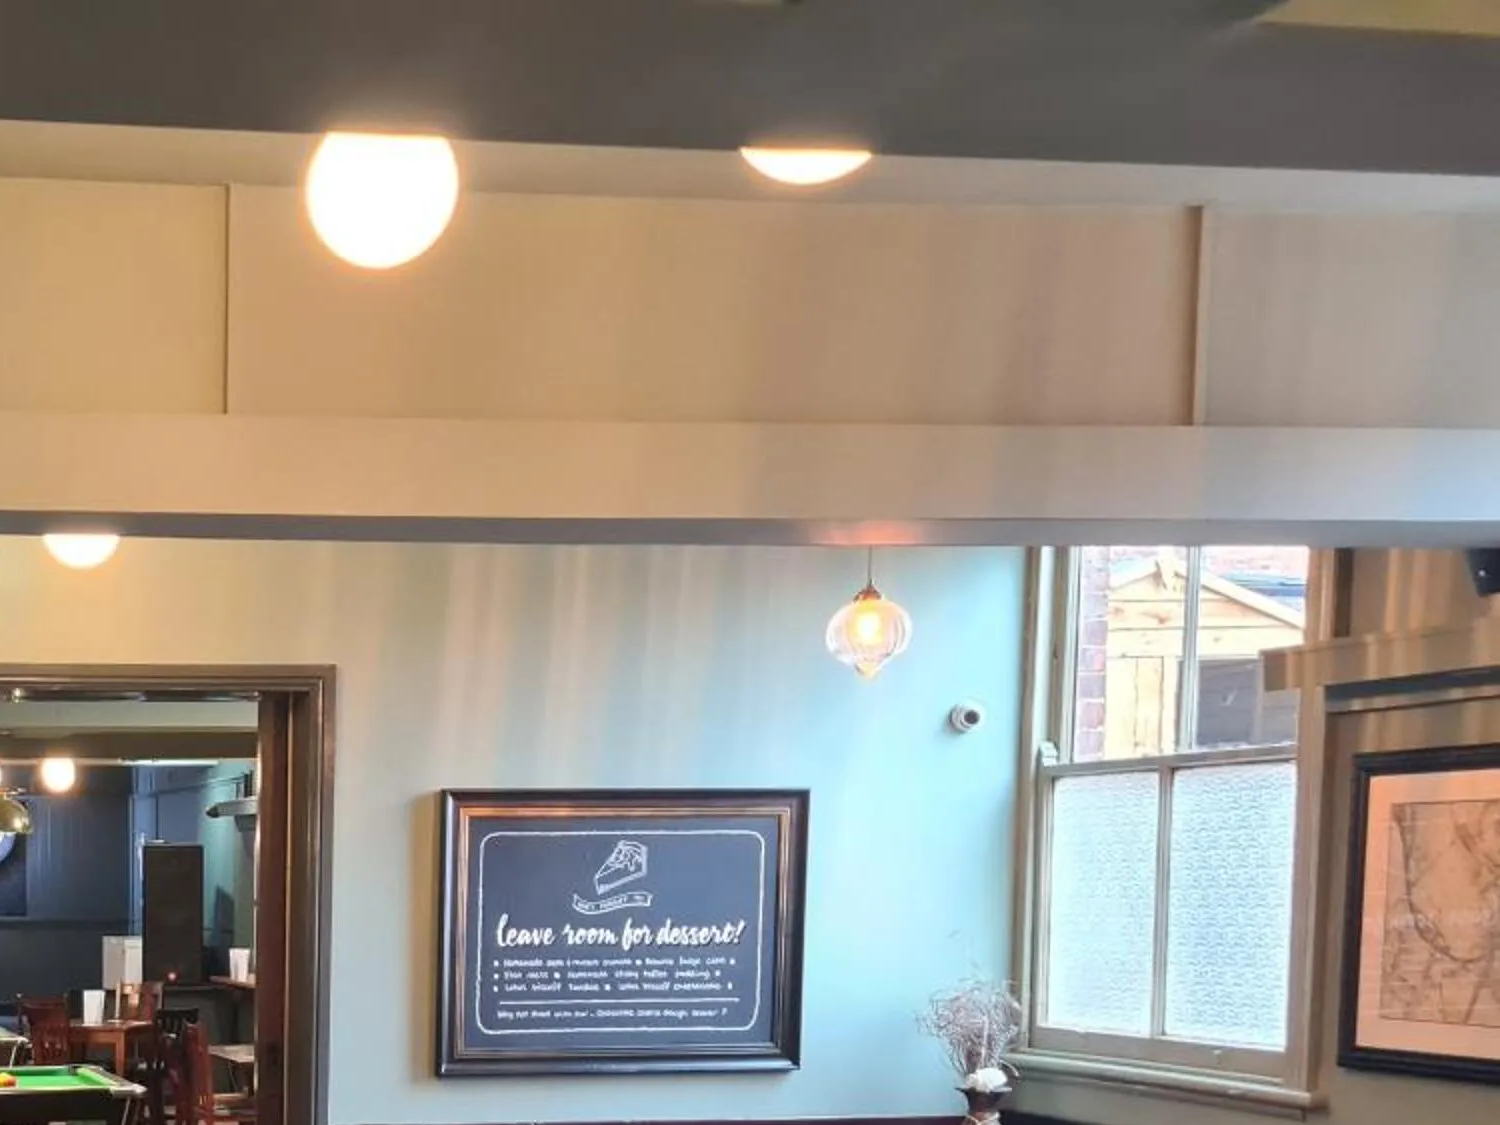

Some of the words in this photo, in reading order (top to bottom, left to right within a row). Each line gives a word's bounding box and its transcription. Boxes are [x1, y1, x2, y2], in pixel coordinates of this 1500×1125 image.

[562, 923, 619, 946] room
[621, 917, 653, 951] for
[656, 917, 746, 945] dessert!
